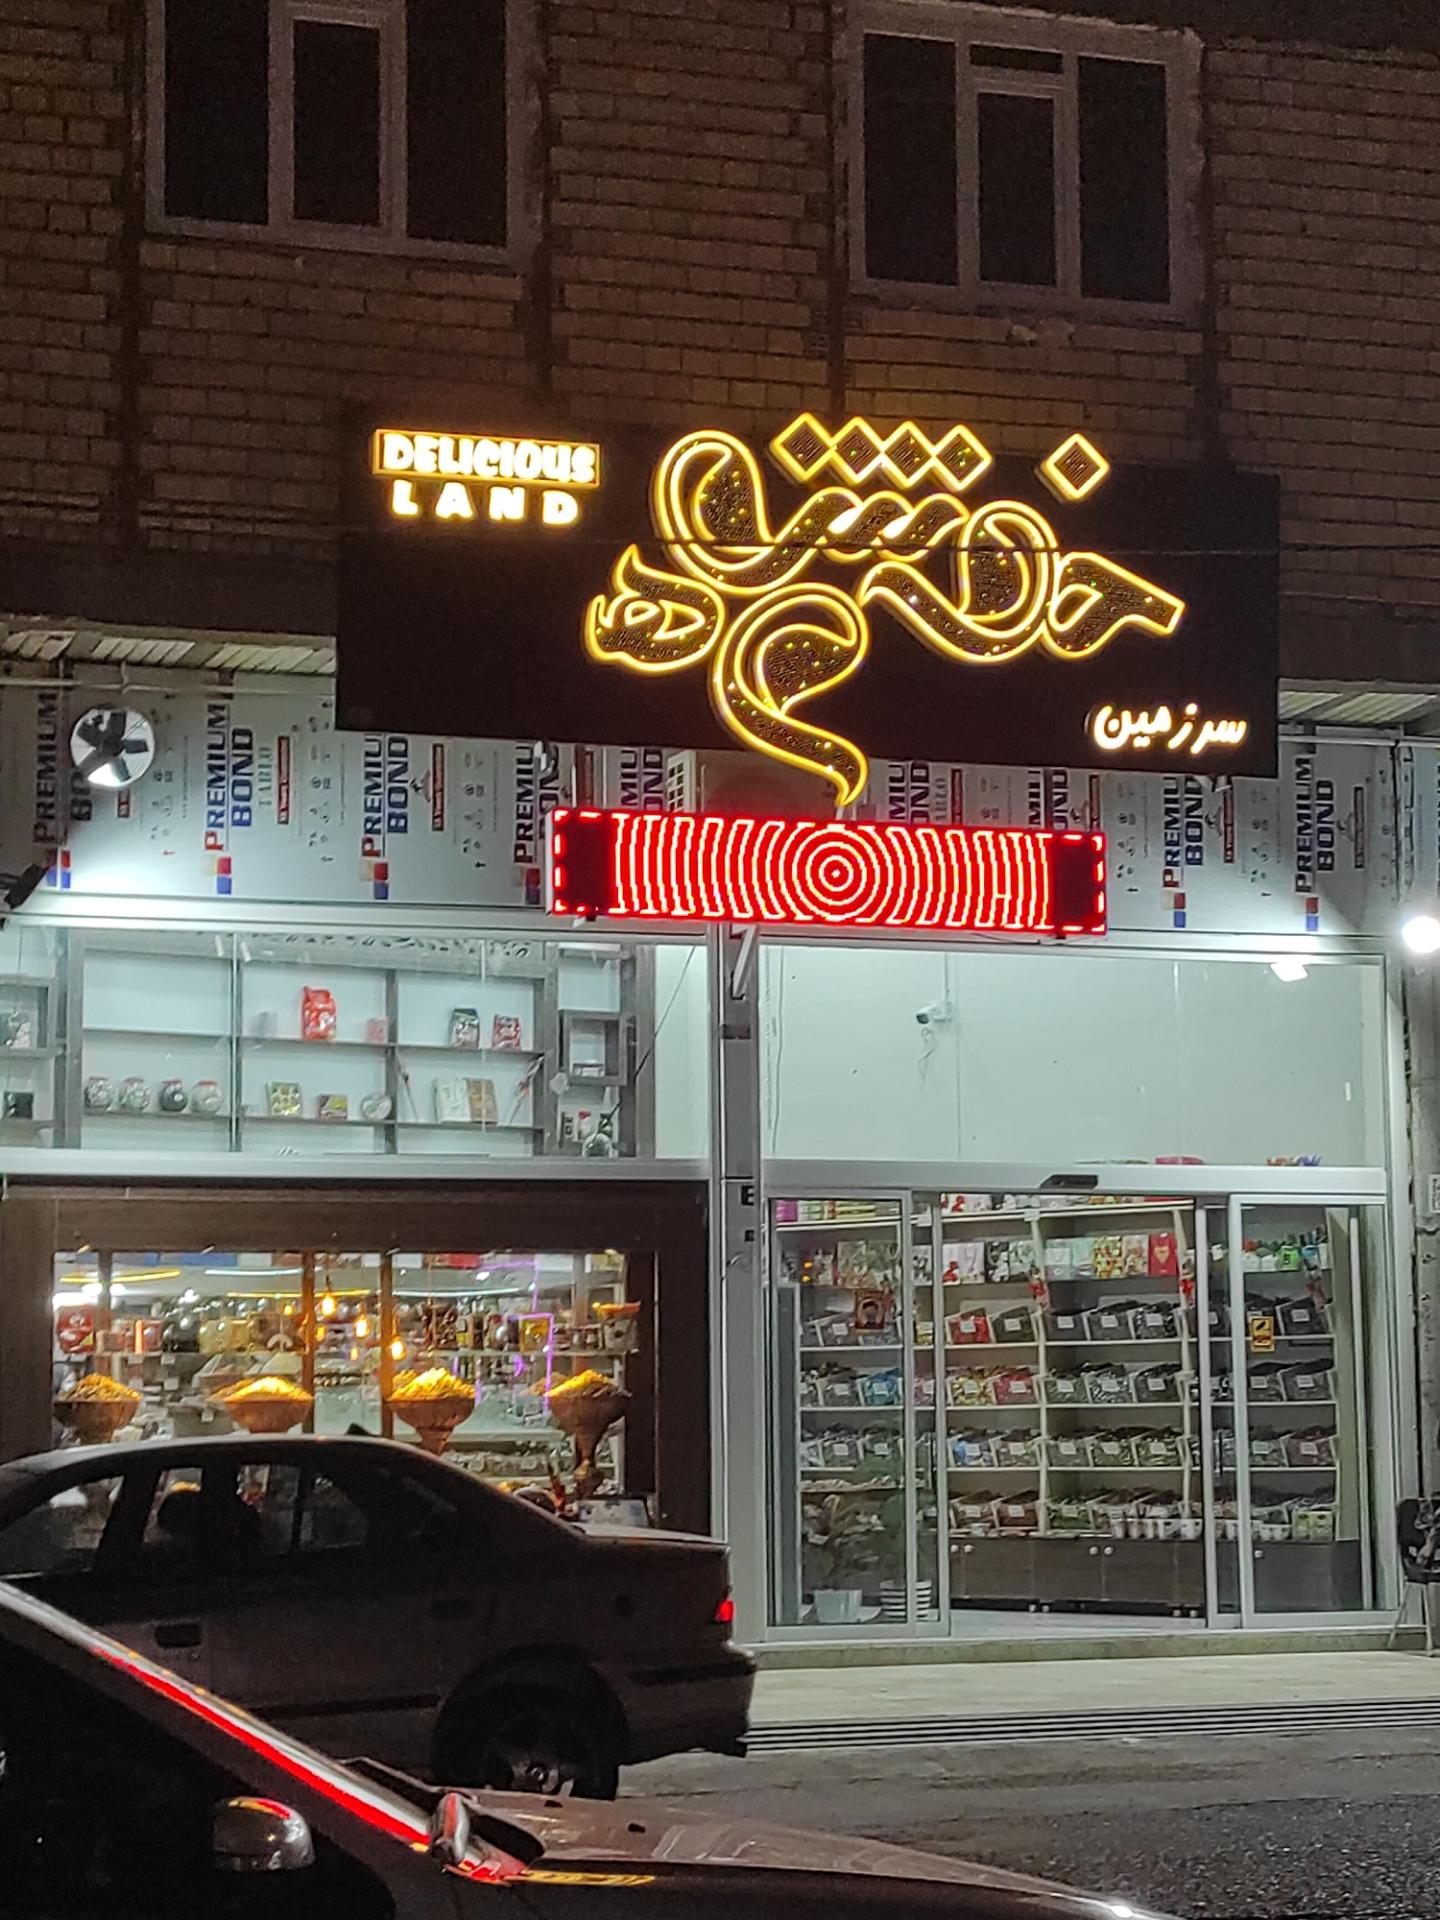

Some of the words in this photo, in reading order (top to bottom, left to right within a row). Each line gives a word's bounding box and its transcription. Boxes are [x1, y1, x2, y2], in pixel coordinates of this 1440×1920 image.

[383, 433, 597, 484] DELICIOUS
[391, 479, 579, 525] LAND
[33, 693, 58, 844] PREMIUM
[1093, 702, 1248, 755] سرزمین
[71, 771, 92, 821] BO
[204, 704, 226, 851] PREMIUM
[231, 728, 253, 828] BOND
[361, 733, 382, 857] PREMIU
[387, 736, 408, 834] BOND
[514, 743, 534, 864] PREMIU
[643, 748, 663, 811] OND
[911, 761, 929, 824] OND
[1052, 769, 1067, 830] OND
[1162, 777, 1181, 888] PREMIU
[1294, 757, 1314, 894] PREMIUM
[1316, 779, 1334, 872] BOND
